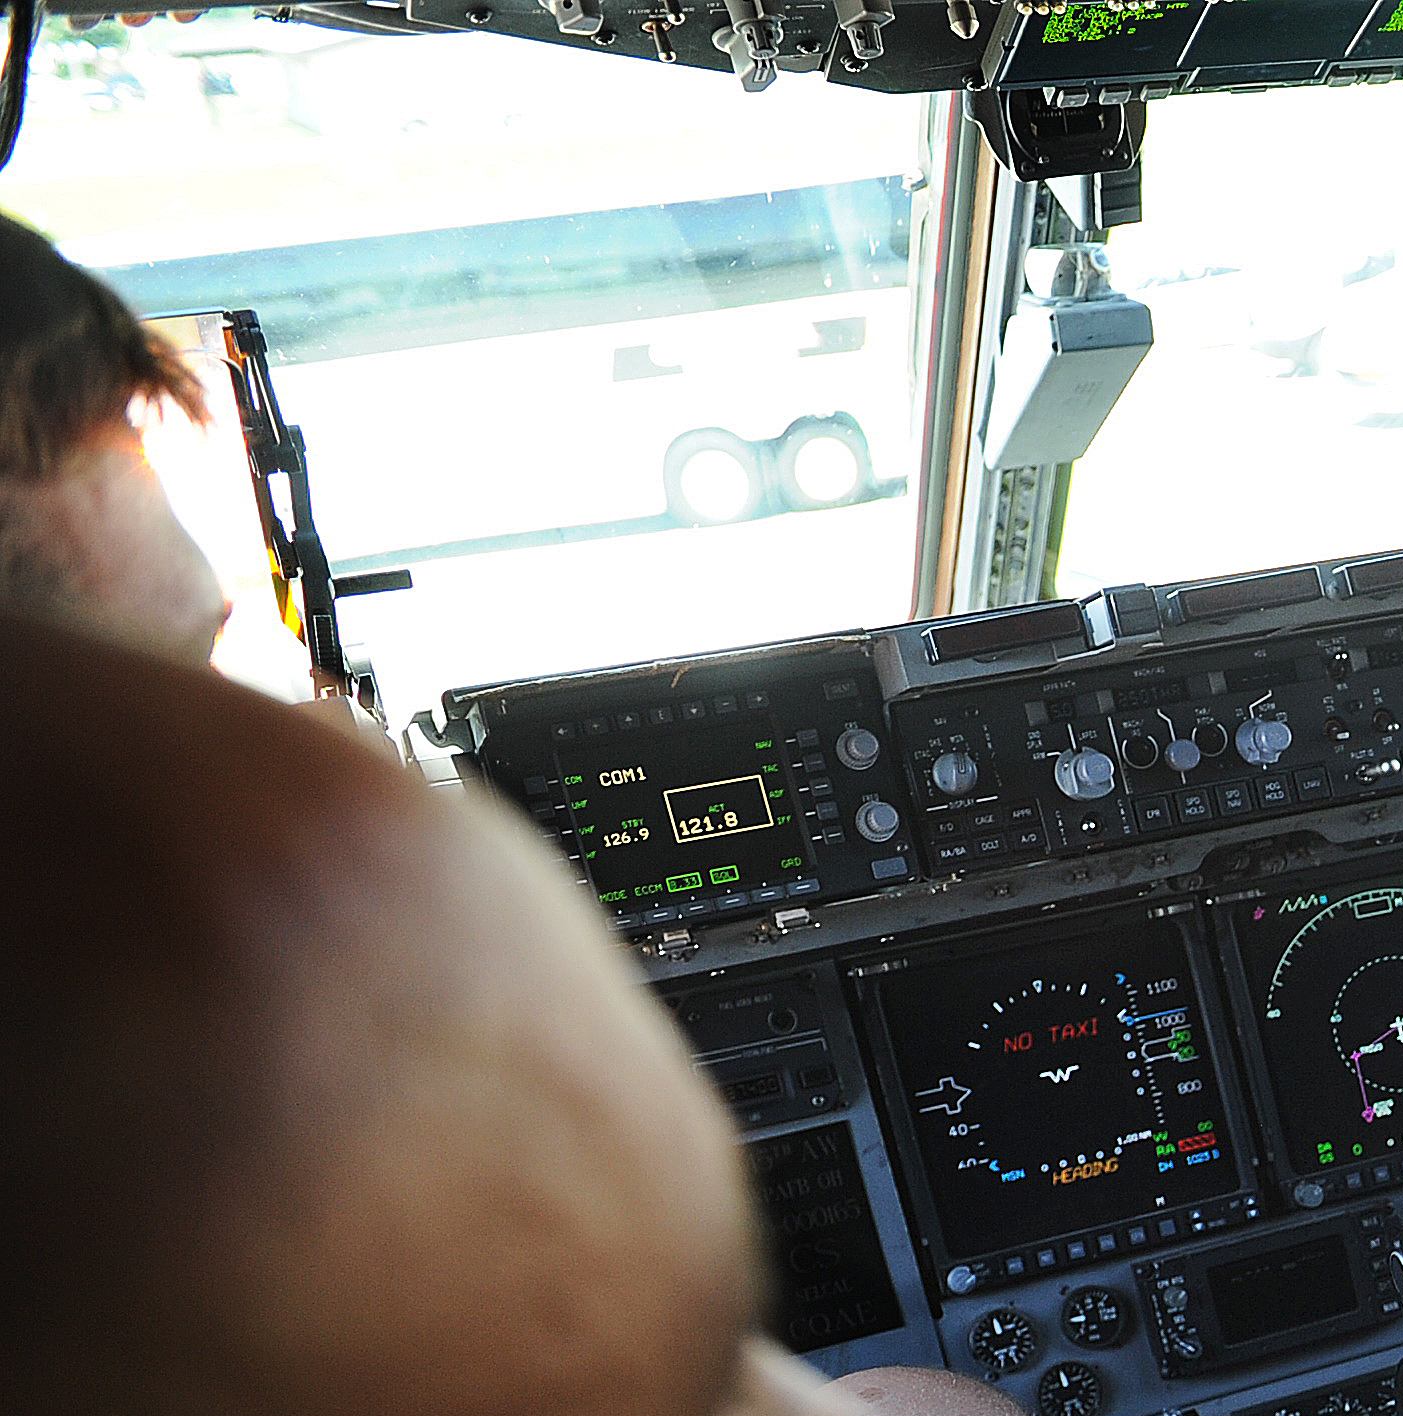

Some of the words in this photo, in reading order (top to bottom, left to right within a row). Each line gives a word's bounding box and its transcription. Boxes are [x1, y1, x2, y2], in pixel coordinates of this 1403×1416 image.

[564, 775, 583, 786] COM
[599, 766, 647, 787] COM1
[678, 811, 739, 837] 121.8
[603, 828, 650, 848] 126.9
[599, 889, 628, 904] MODE
[1146, 978, 1178, 995] 1100
[1154, 1012, 1186, 1029] 1000
[1004, 1032, 1033, 1053] NO
[1049, 1017, 1099, 1043] TAXI
[1052, 1156, 1119, 1186] HEADING
